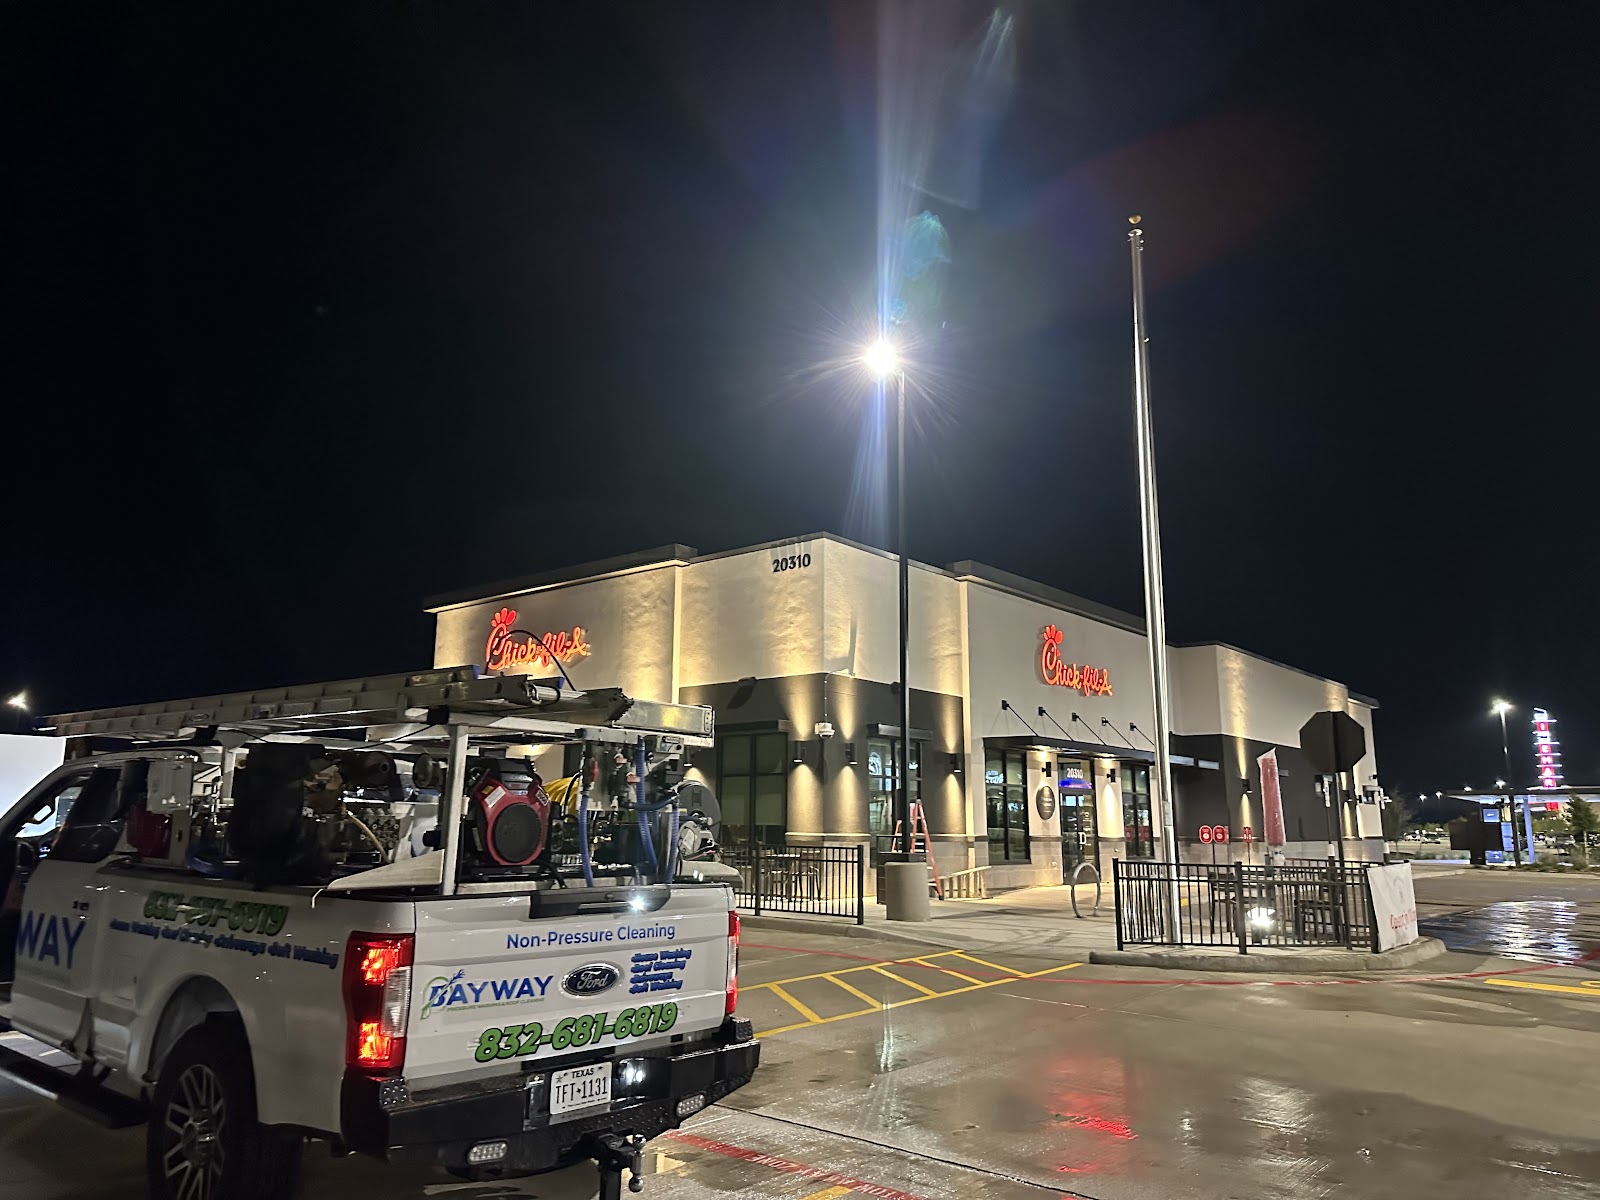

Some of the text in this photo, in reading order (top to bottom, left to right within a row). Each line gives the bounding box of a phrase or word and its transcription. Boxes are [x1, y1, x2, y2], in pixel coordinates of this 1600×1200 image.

[772, 553, 812, 573] 20310
[486, 622, 588, 670] Chick-fil-A
[1042, 637, 1114, 697] Chick-fil-A
[1066, 767, 1084, 780] 20310
[506, 923, 676, 949] Non-Pressure Cleaning
[429, 975, 554, 1008] BAYWAY
[577, 970, 609, 990] Ford
[475, 1002, 678, 1062] 832-681-6819
[572, 1067, 595, 1079] TEXAS
